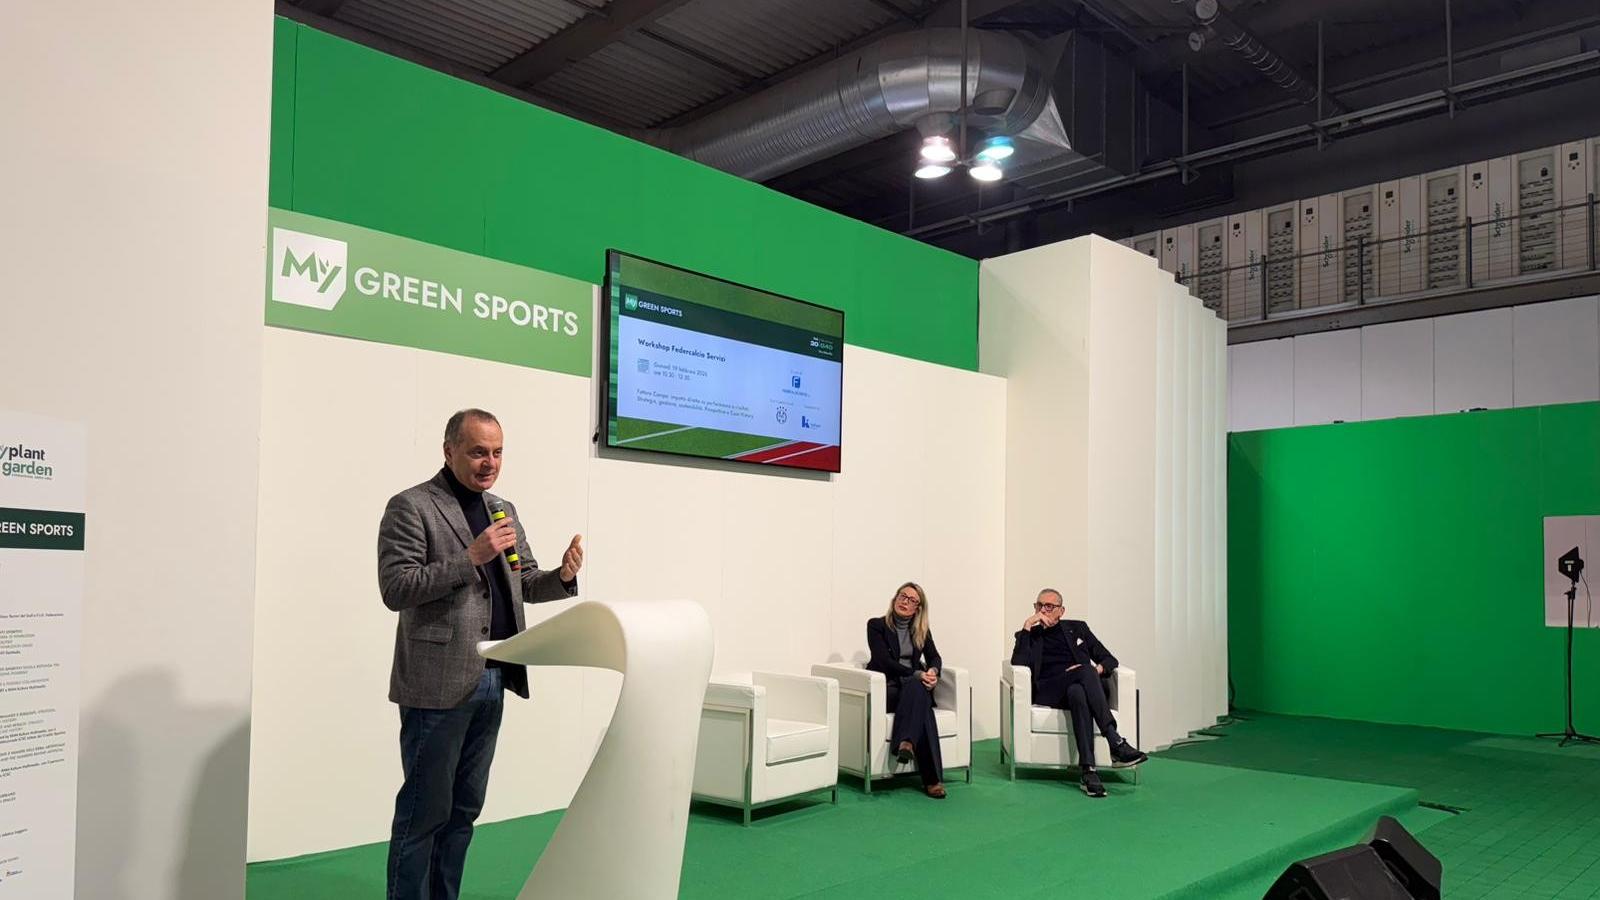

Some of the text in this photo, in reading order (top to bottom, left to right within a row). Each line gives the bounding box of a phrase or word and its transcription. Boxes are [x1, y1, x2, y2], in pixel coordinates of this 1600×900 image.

[354, 267, 463, 315] GREEN
[473, 292, 579, 337] SPORTS
[638, 301, 660, 312] GREEN
[660, 307, 683, 317] SPORTS
[637, 338, 726, 362] Workshop Federcalcio Servizi
[2, 461, 53, 477] garden
[29, 523, 74, 537] SPORTS
